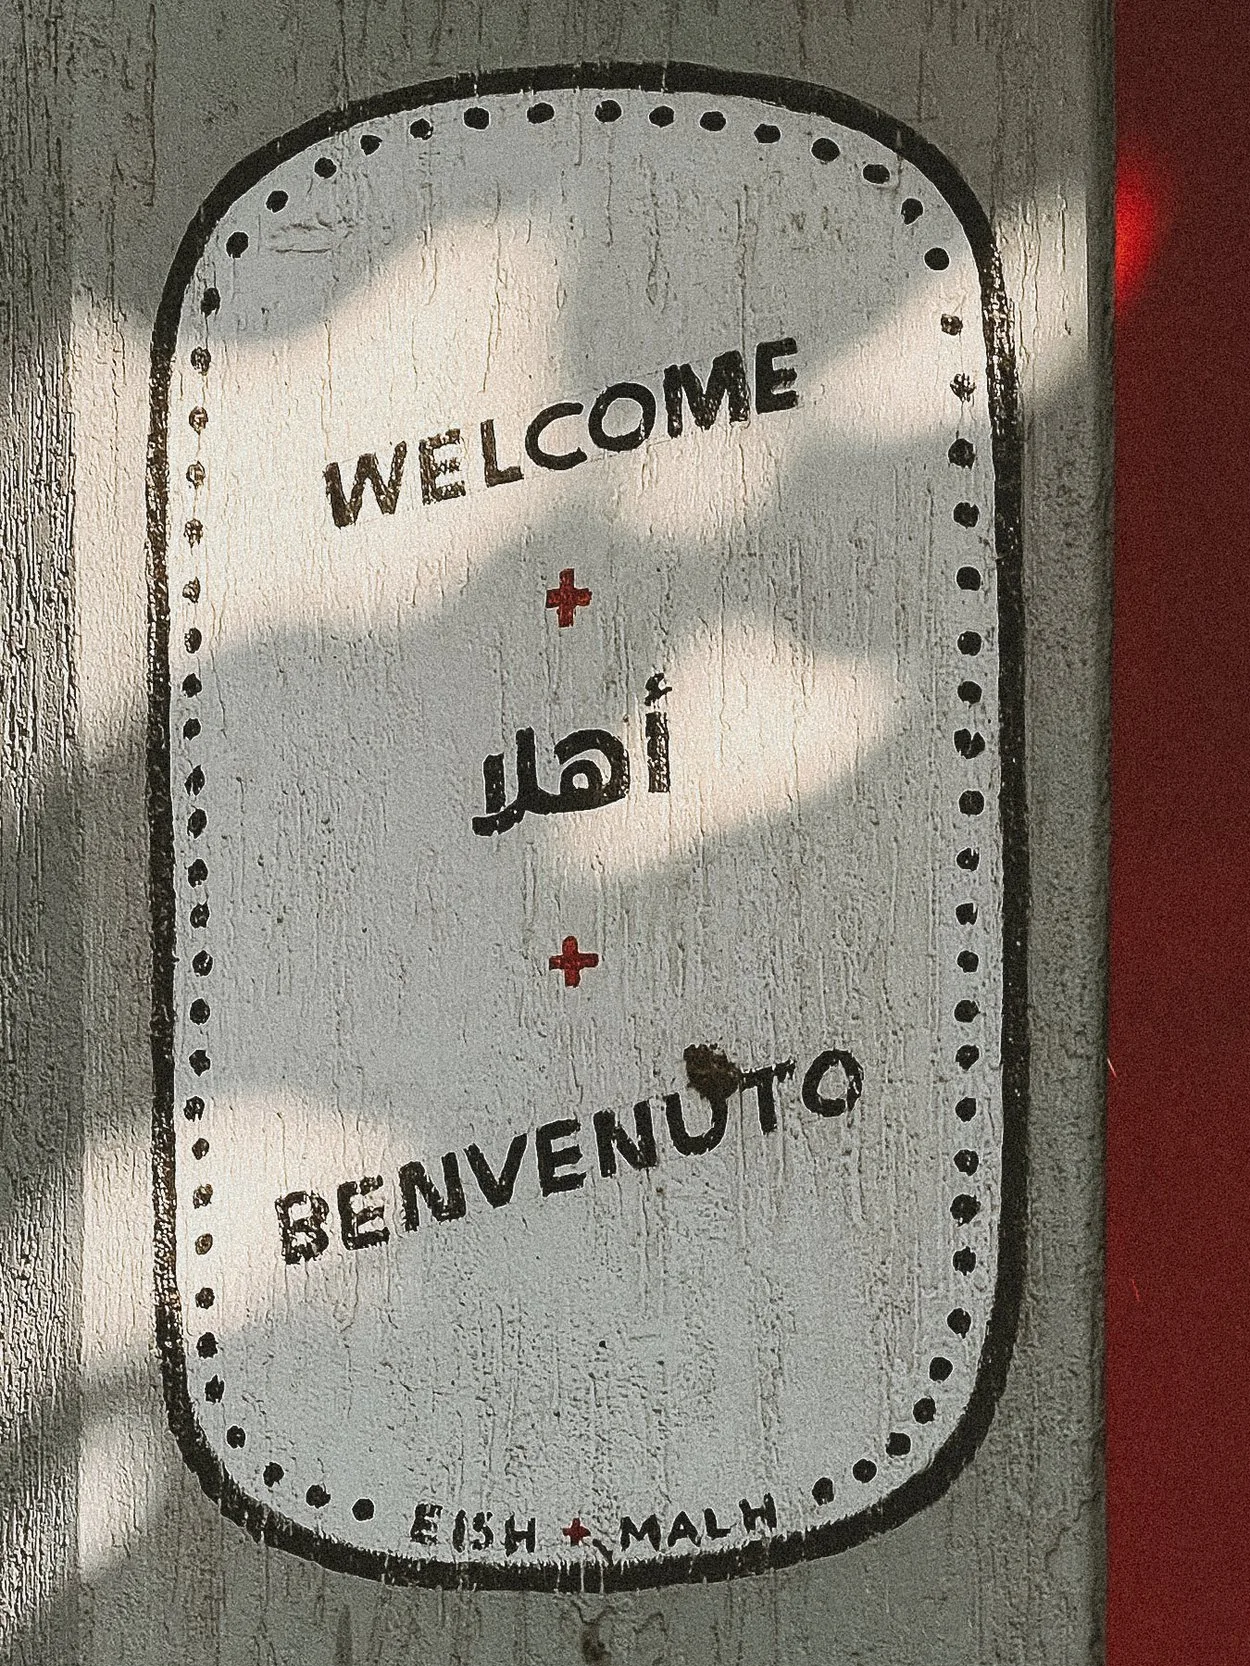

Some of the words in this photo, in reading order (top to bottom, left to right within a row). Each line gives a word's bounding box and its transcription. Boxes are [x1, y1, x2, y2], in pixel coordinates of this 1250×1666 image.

[322, 337, 799, 528] WELCOME
[472, 672, 671, 836] أهلا
[274, 1048, 865, 1265] BENVENUTO
[410, 1504, 536, 1554] EISH
[619, 1493, 777, 1551] MALH
